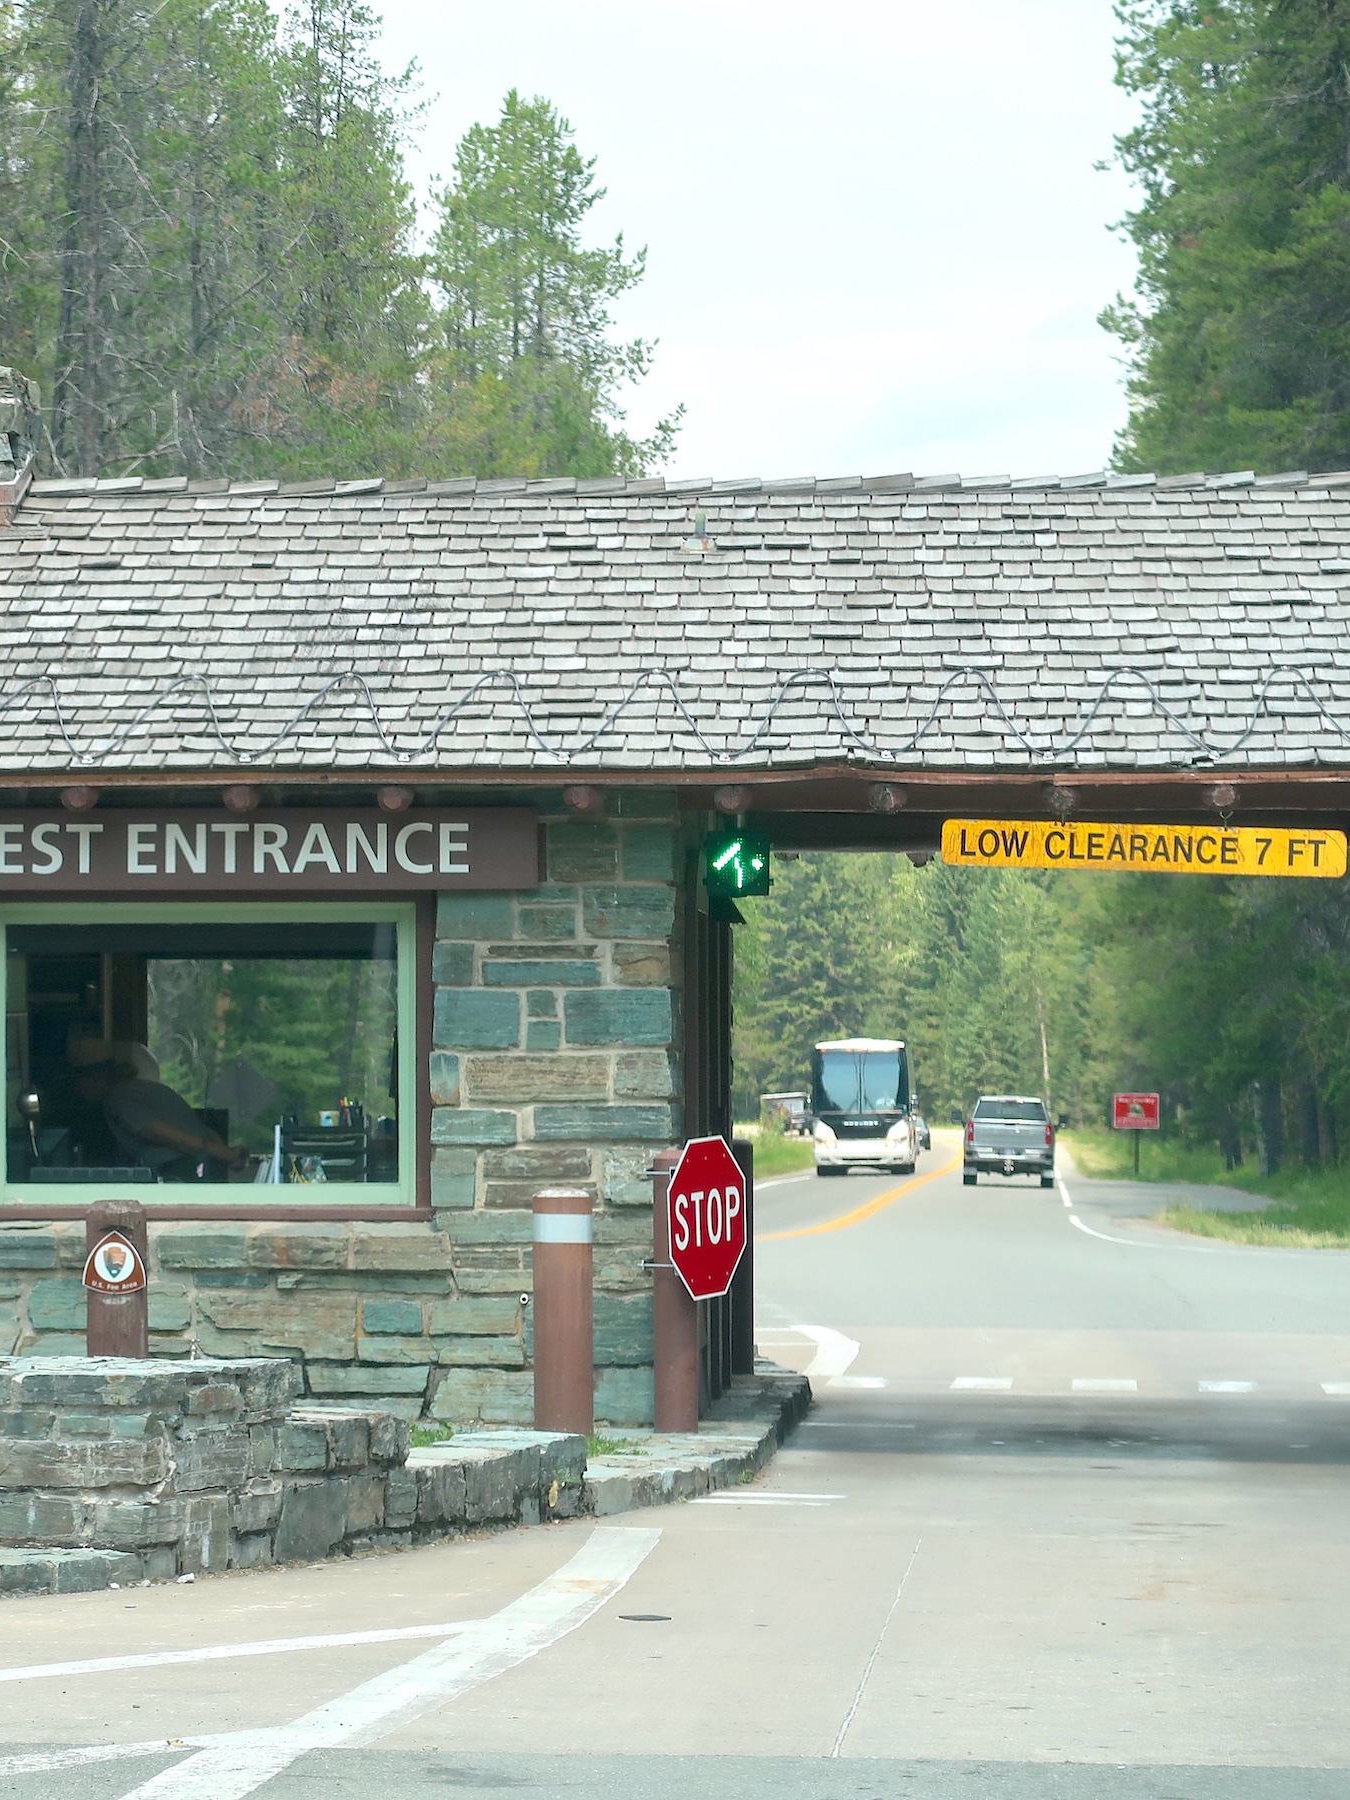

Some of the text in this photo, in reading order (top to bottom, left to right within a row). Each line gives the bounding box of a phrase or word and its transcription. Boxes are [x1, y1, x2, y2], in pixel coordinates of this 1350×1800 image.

[127, 822, 470, 875] ENTRANCE
[960, 828, 1327, 867] LOW CLEARANCE 7 FT
[674, 1185, 741, 1252] STOP
